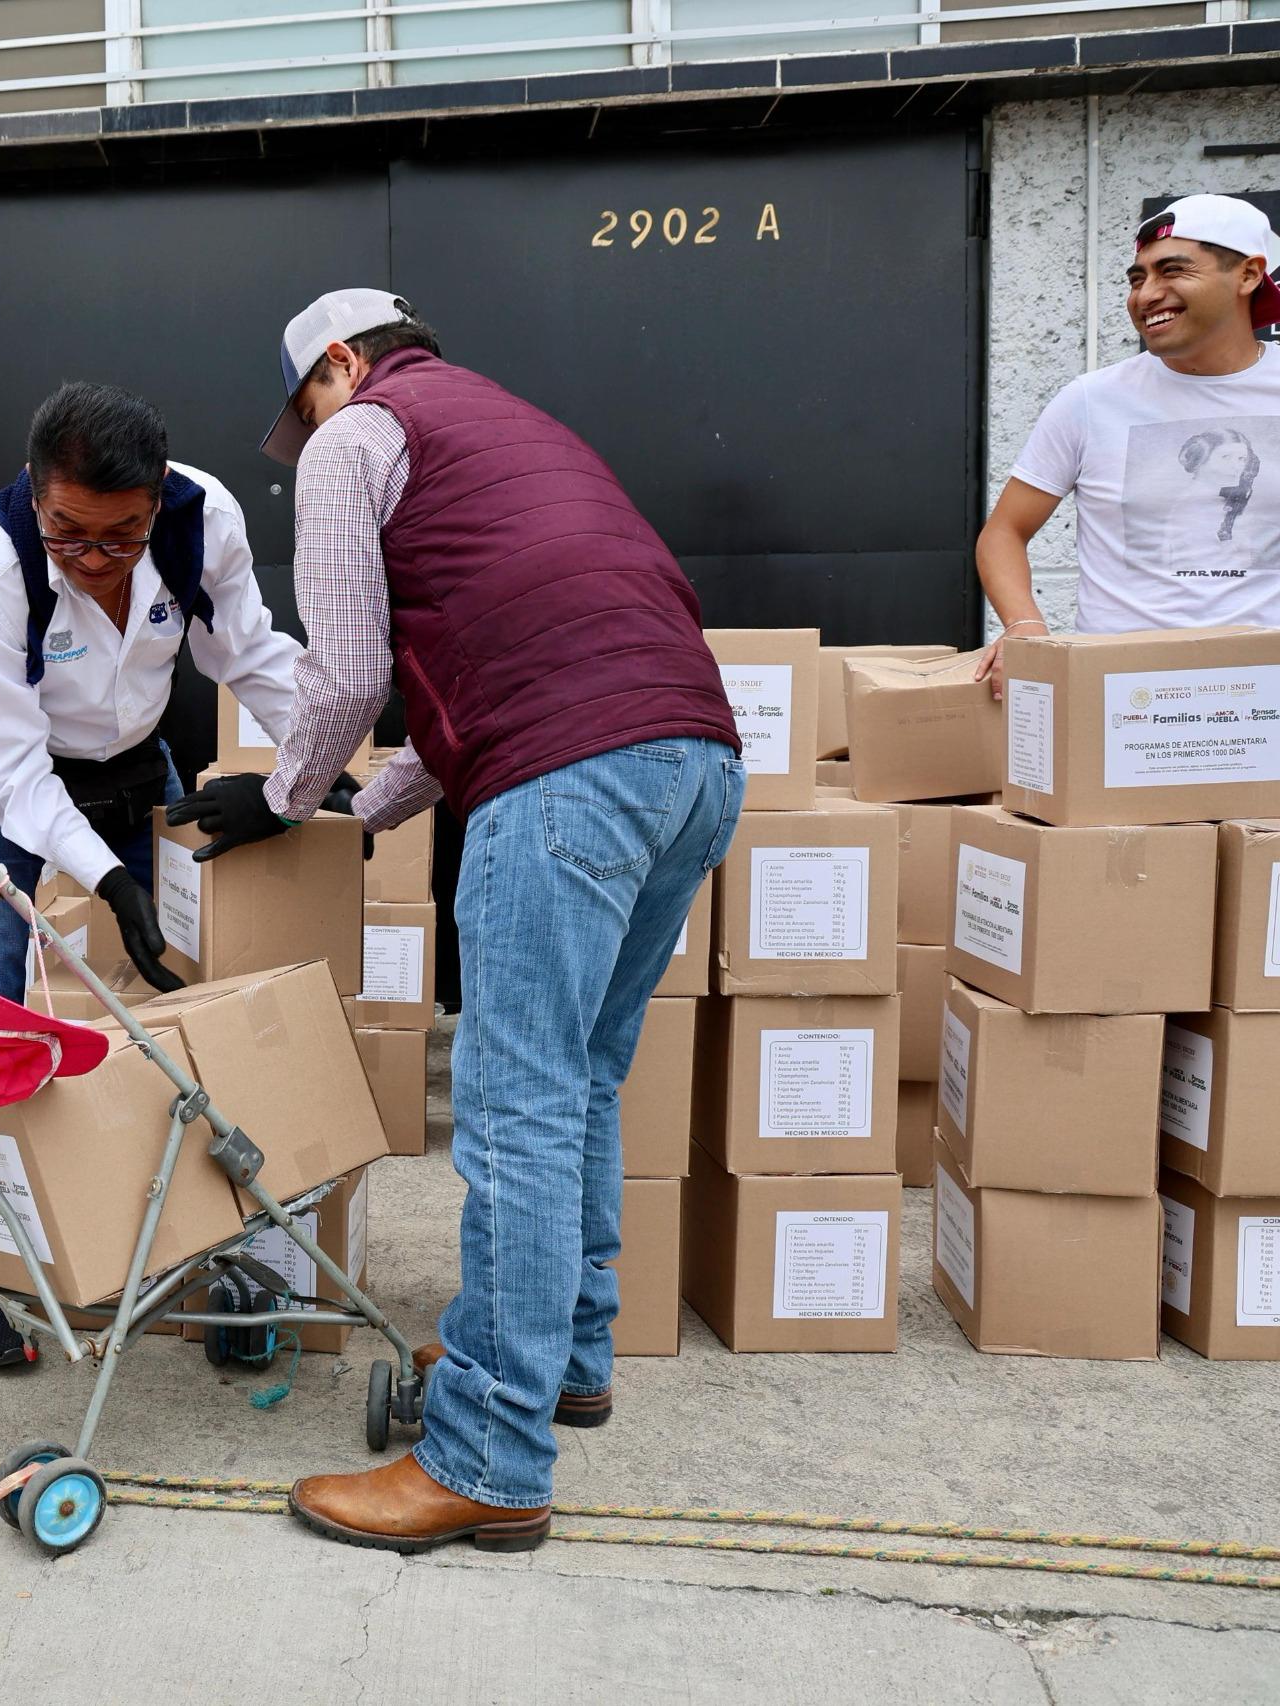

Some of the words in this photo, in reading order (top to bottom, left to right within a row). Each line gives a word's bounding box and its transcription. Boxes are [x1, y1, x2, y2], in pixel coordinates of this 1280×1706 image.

[592, 206, 720, 249] 2902
[756, 204, 780, 240] A
[1210, 570, 1247, 578] WARS
[1156, 692, 1192, 700] MÉXICO
[1153, 712, 1202, 724] Familias
[1124, 742, 1170, 751] PROGRAMAS
[1183, 739, 1218, 748] ATENCIÓN
[1220, 738, 1267, 746] ALIMENTARIA
